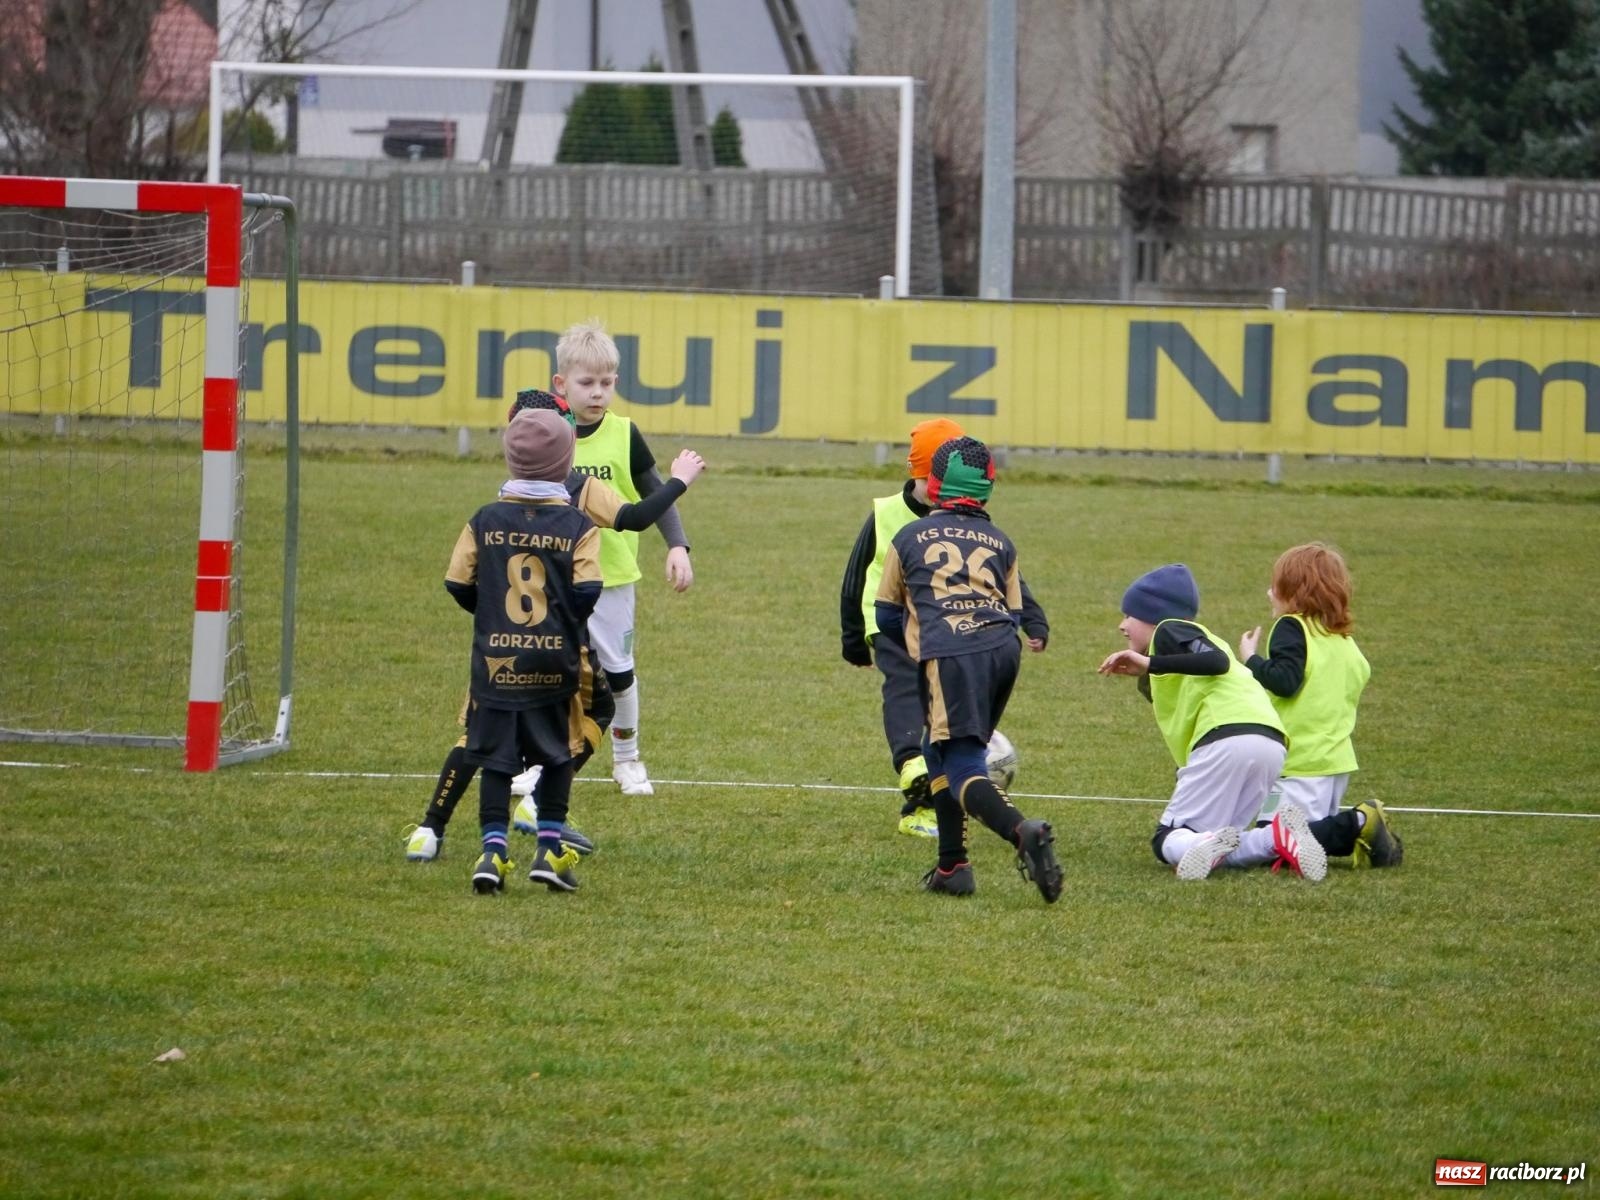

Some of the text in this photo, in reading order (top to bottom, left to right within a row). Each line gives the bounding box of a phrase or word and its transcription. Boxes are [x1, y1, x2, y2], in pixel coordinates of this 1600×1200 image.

[85, 287, 783, 434] Trenuj
[906, 344, 998, 415] z
[571, 464, 612, 481] ma
[484, 531, 572, 552] KS CZARNI
[916, 527, 1003, 550] KS CZARNI
[923, 540, 1007, 601] 26
[505, 552, 548, 627] 8
[489, 633, 563, 650] GORZYCE
[495, 670, 563, 685] abastran
